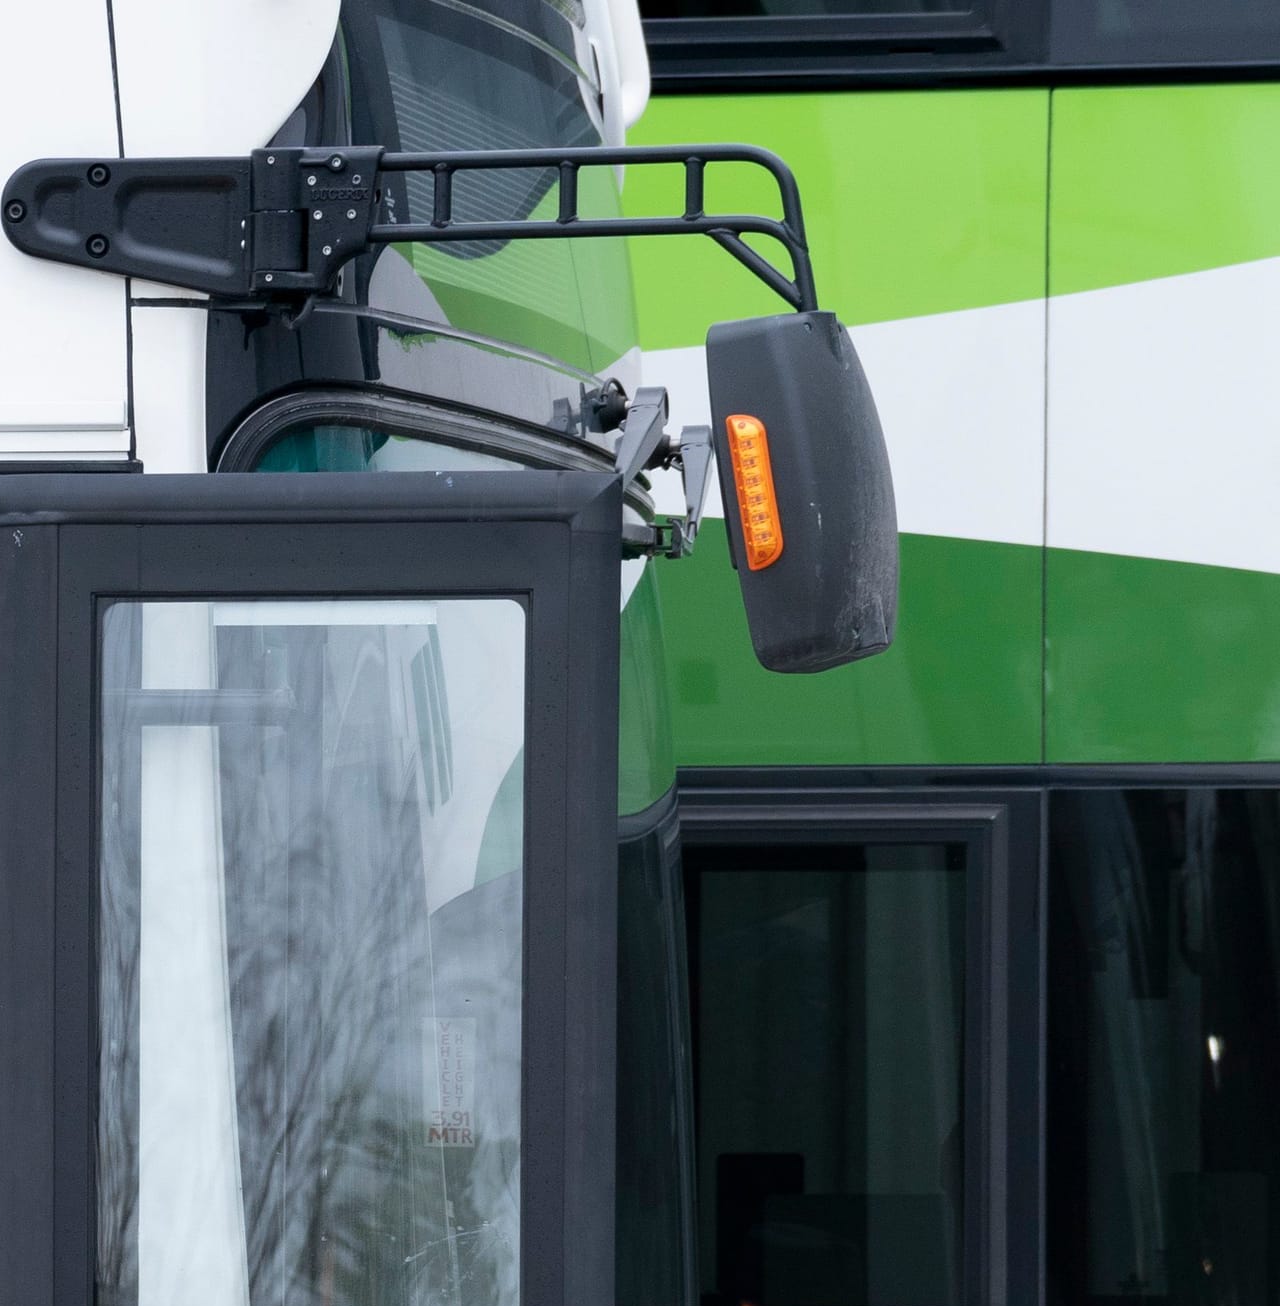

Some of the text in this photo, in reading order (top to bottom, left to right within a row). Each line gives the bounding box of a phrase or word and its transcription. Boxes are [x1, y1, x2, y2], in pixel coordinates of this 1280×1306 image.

[440, 1022, 451, 1107] VEHICLE
[455, 1034, 464, 1107] HEIGHT
[427, 1128, 473, 1143] MTR
[431, 1111, 470, 1127] 3.91
